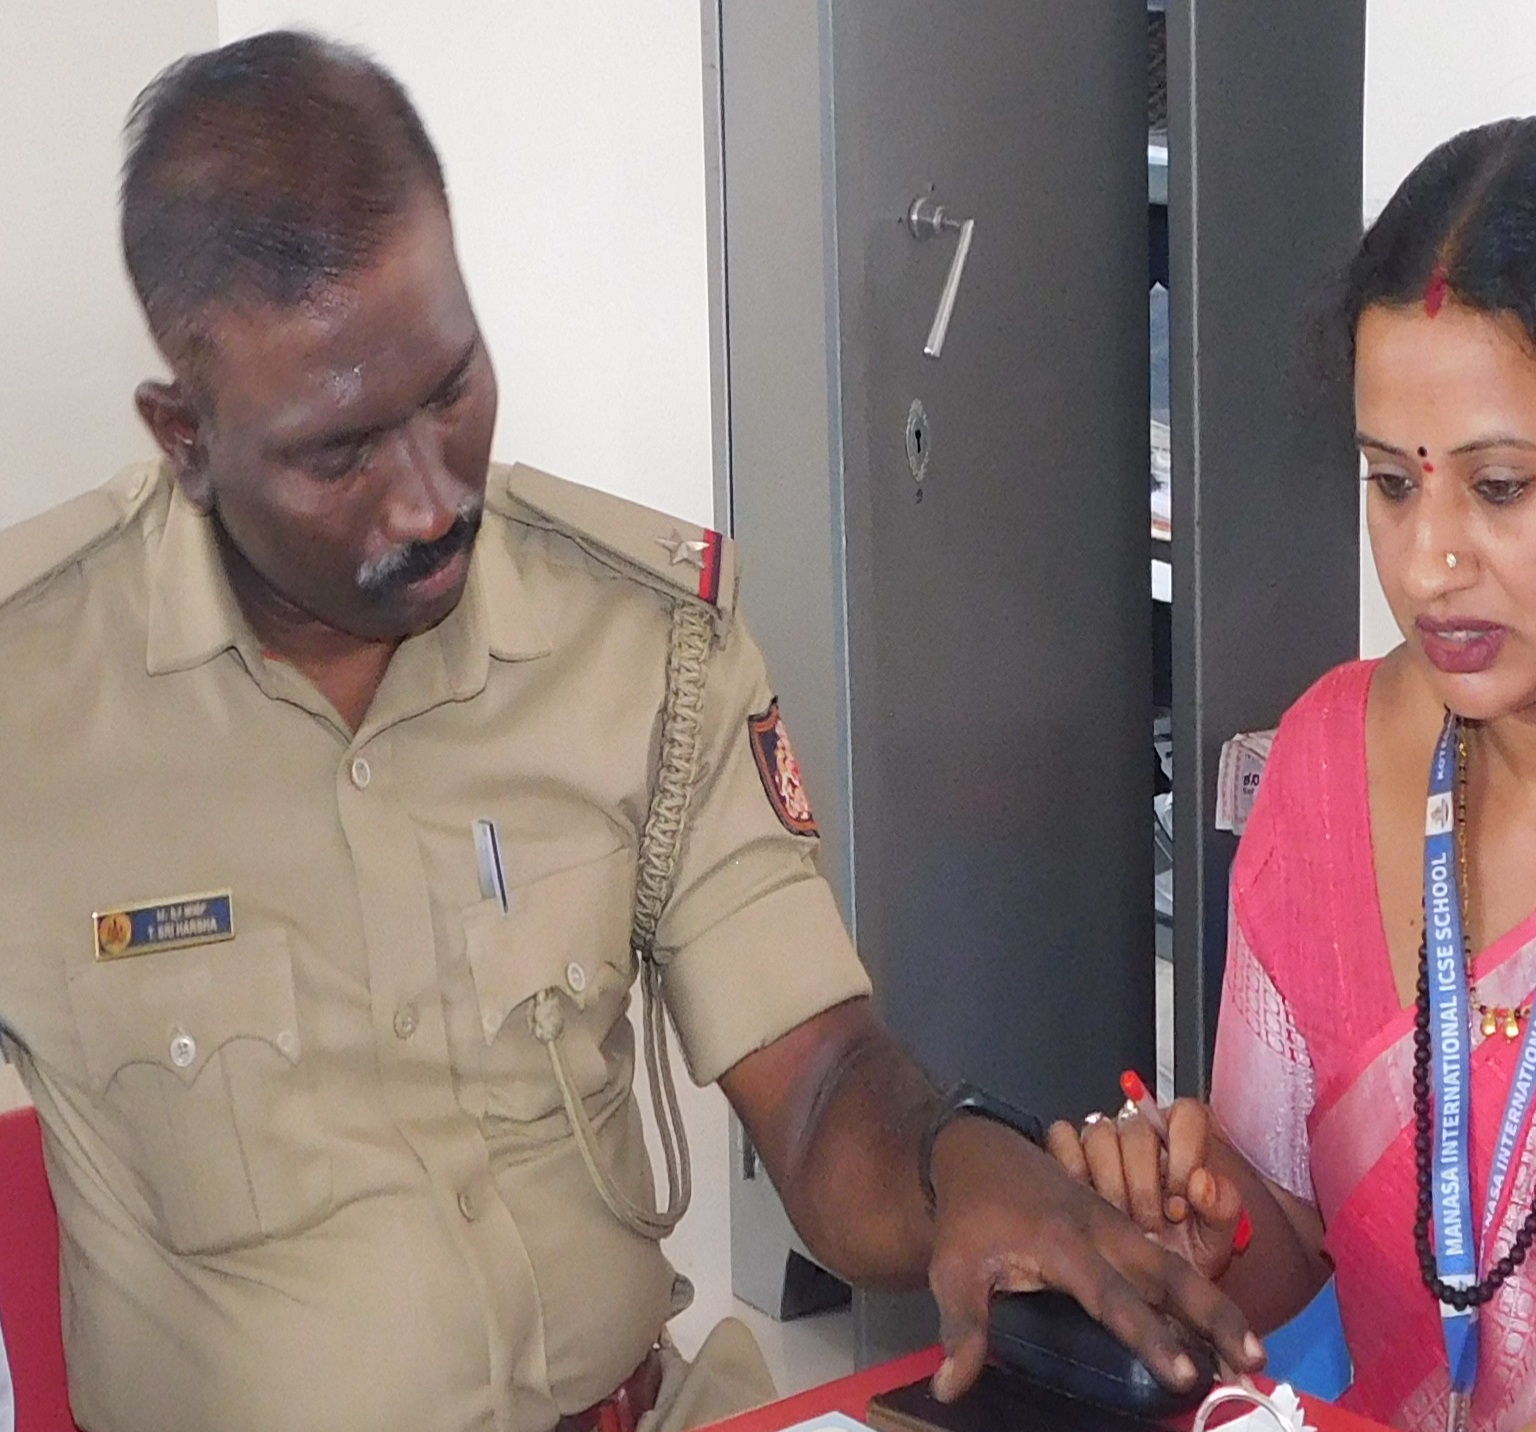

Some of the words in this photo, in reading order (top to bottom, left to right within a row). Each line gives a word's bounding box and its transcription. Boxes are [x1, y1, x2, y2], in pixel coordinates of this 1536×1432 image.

[1431, 852, 1452, 941] SCHOOL
[1436, 945, 1457, 992] ICSE
[1440, 995, 1462, 1164] INTERNATIONAL
[1440, 1167, 1464, 1256] MANASA
[1484, 1173, 1505, 1228] NASA
